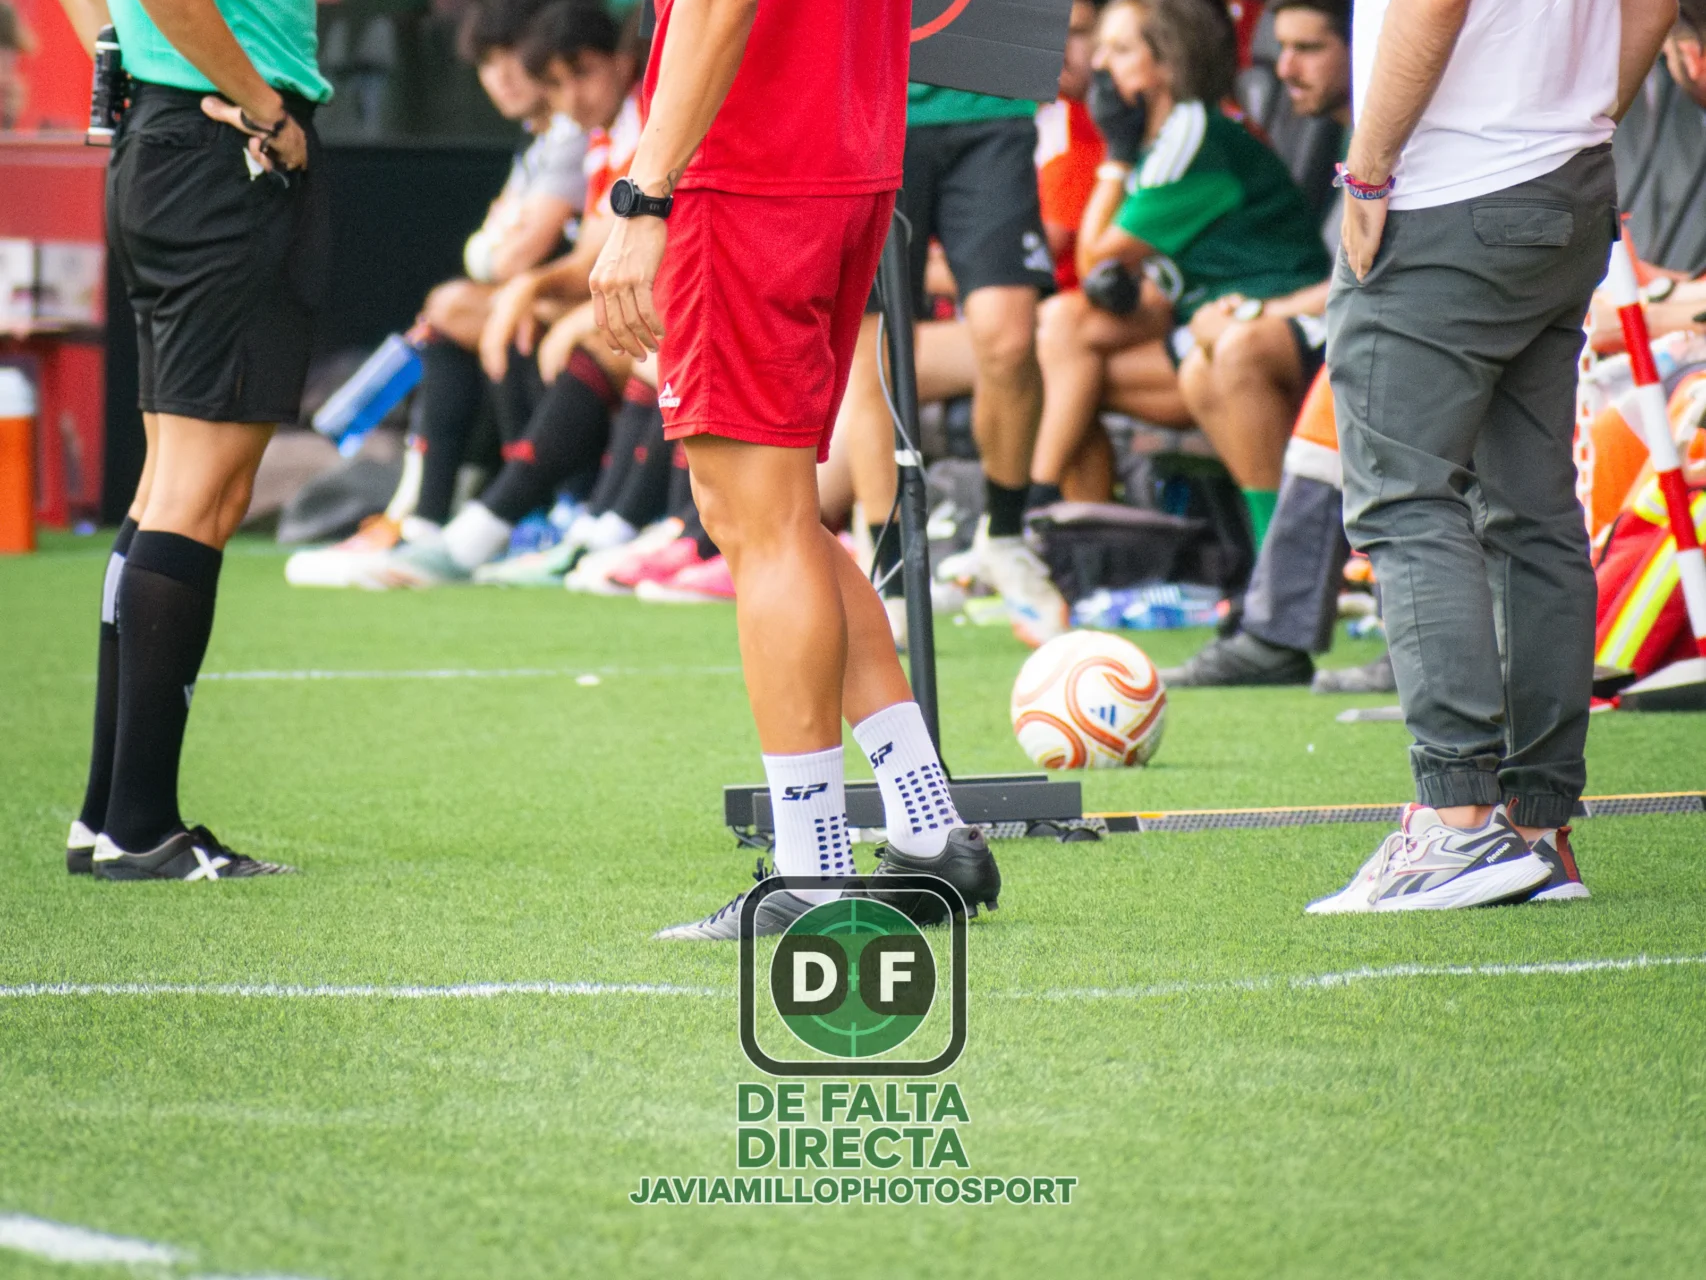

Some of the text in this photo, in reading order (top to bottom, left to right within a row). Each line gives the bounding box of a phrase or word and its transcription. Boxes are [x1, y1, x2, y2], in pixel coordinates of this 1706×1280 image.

[868, 741, 893, 769] SP
[781, 782, 828, 800] SP
[1486, 842, 1511, 864] Reebok
